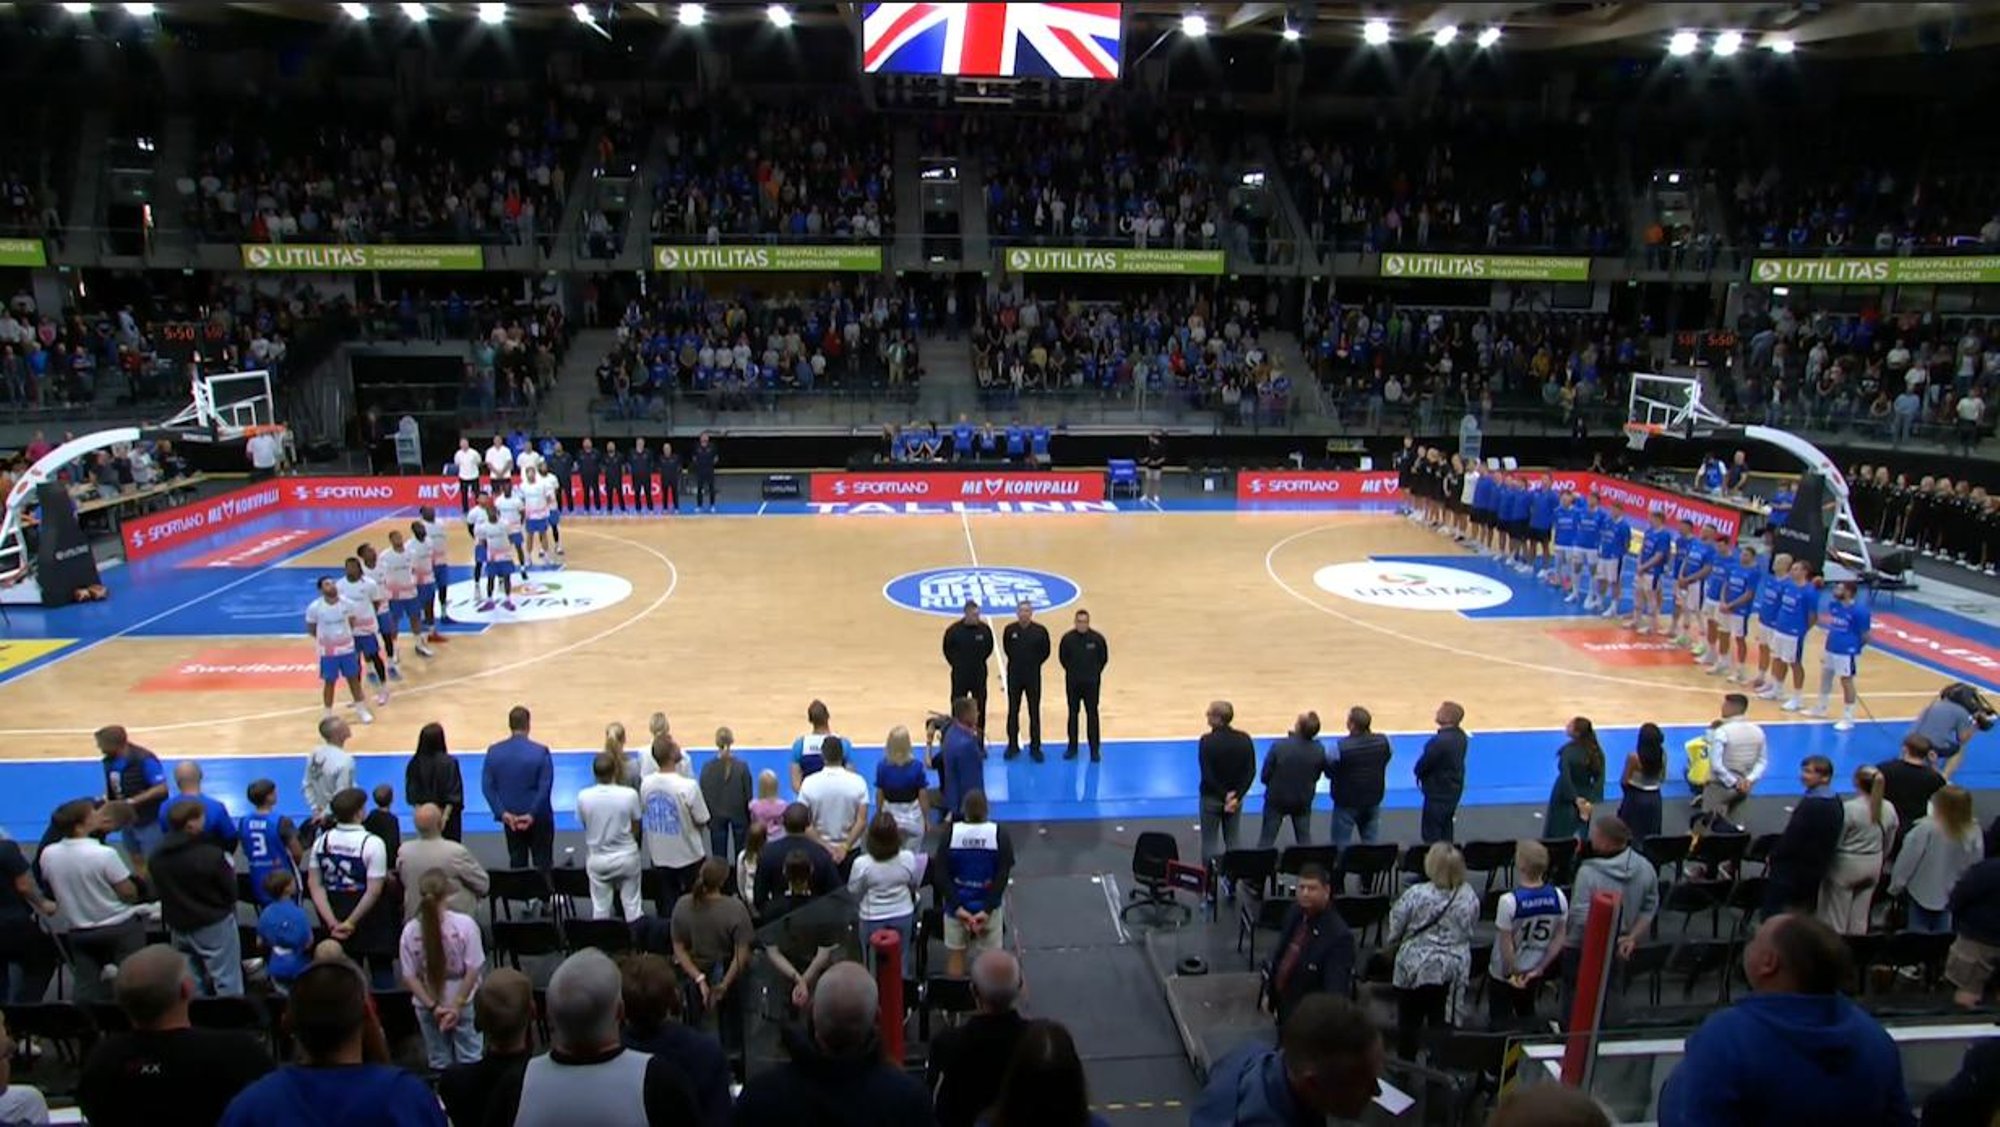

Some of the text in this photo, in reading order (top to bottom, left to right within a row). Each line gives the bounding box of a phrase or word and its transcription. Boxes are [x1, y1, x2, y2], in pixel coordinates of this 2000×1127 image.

[275, 248, 366, 266] UTILITAS
[684, 249, 769, 268] UTILITAS
[1034, 251, 1116, 270] UTILITAS
[1408, 257, 1485, 276] UTILITAS
[1785, 261, 1889, 280] UTILITAS
[315, 485, 441, 499] SPORTLAND ME
[852, 480, 1080, 494] SPORTLAND ME KORVPALLI
[1268, 479, 1382, 493] SPORTLAND ME
[806, 501, 1118, 514] TALLINN
[148, 512, 204, 542] SPORTLAND
[1354, 586, 1492, 597] UTILITAS
[250, 832, 267, 857] 3
[1521, 920, 1551, 941] 15
